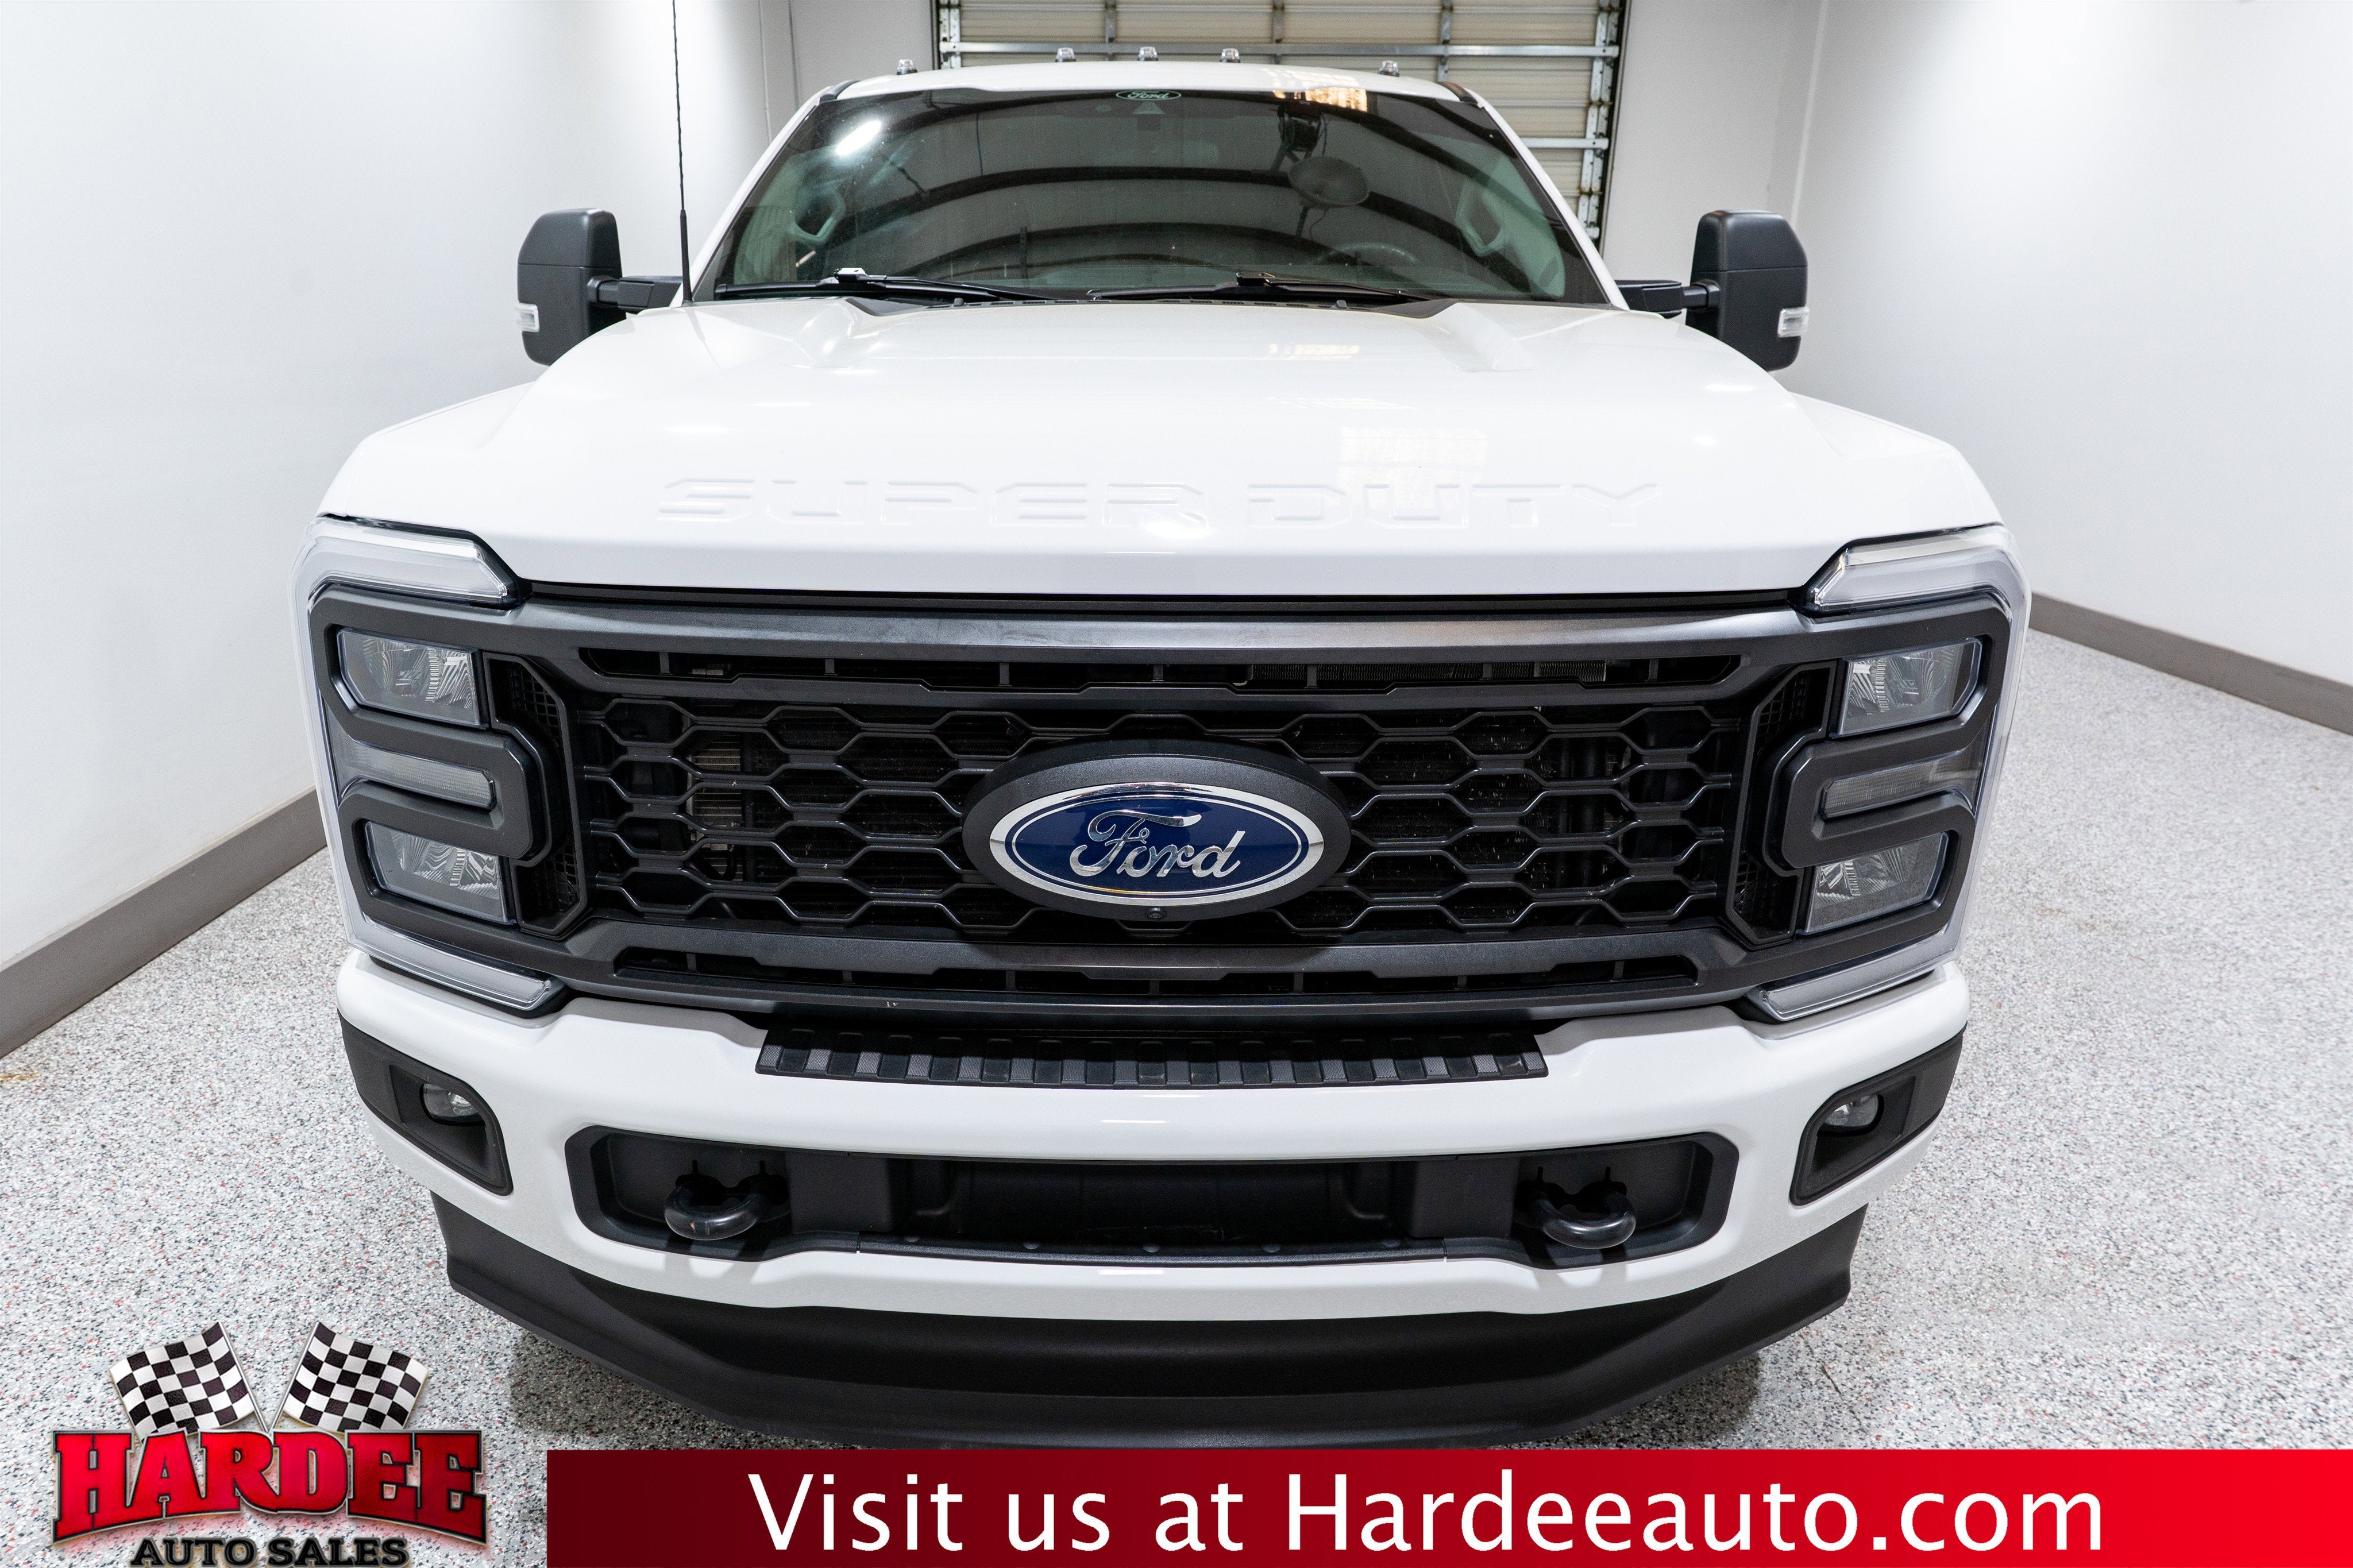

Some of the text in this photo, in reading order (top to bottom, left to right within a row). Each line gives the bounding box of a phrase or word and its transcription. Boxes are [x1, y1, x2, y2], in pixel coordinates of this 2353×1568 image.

[1127, 90, 1170, 99] Ford
[657, 477, 1662, 532] SUPER DUTY
[1069, 809, 1246, 878] Ford
